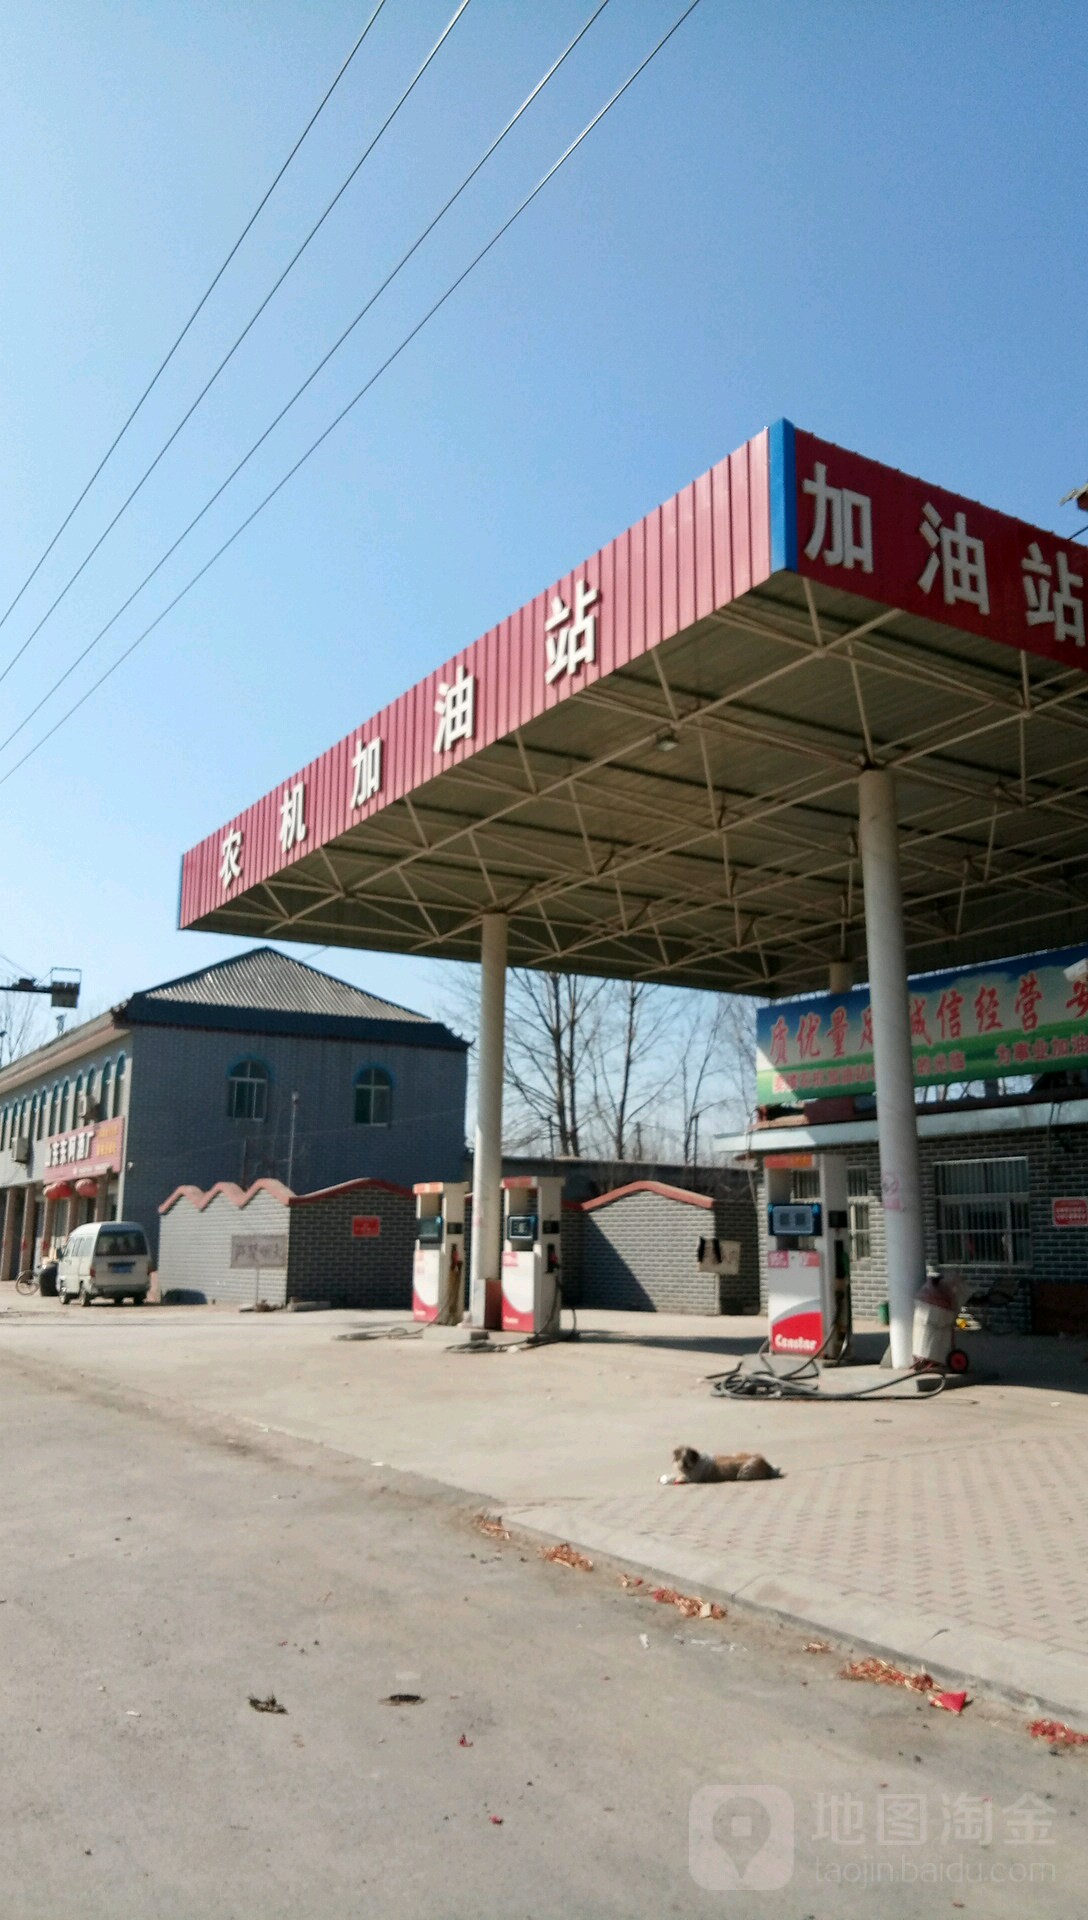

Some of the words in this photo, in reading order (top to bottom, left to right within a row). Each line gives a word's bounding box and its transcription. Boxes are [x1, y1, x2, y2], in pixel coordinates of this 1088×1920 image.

[802, 461, 1086, 647] 加油站
[219, 579, 599, 889] 农机加油站
